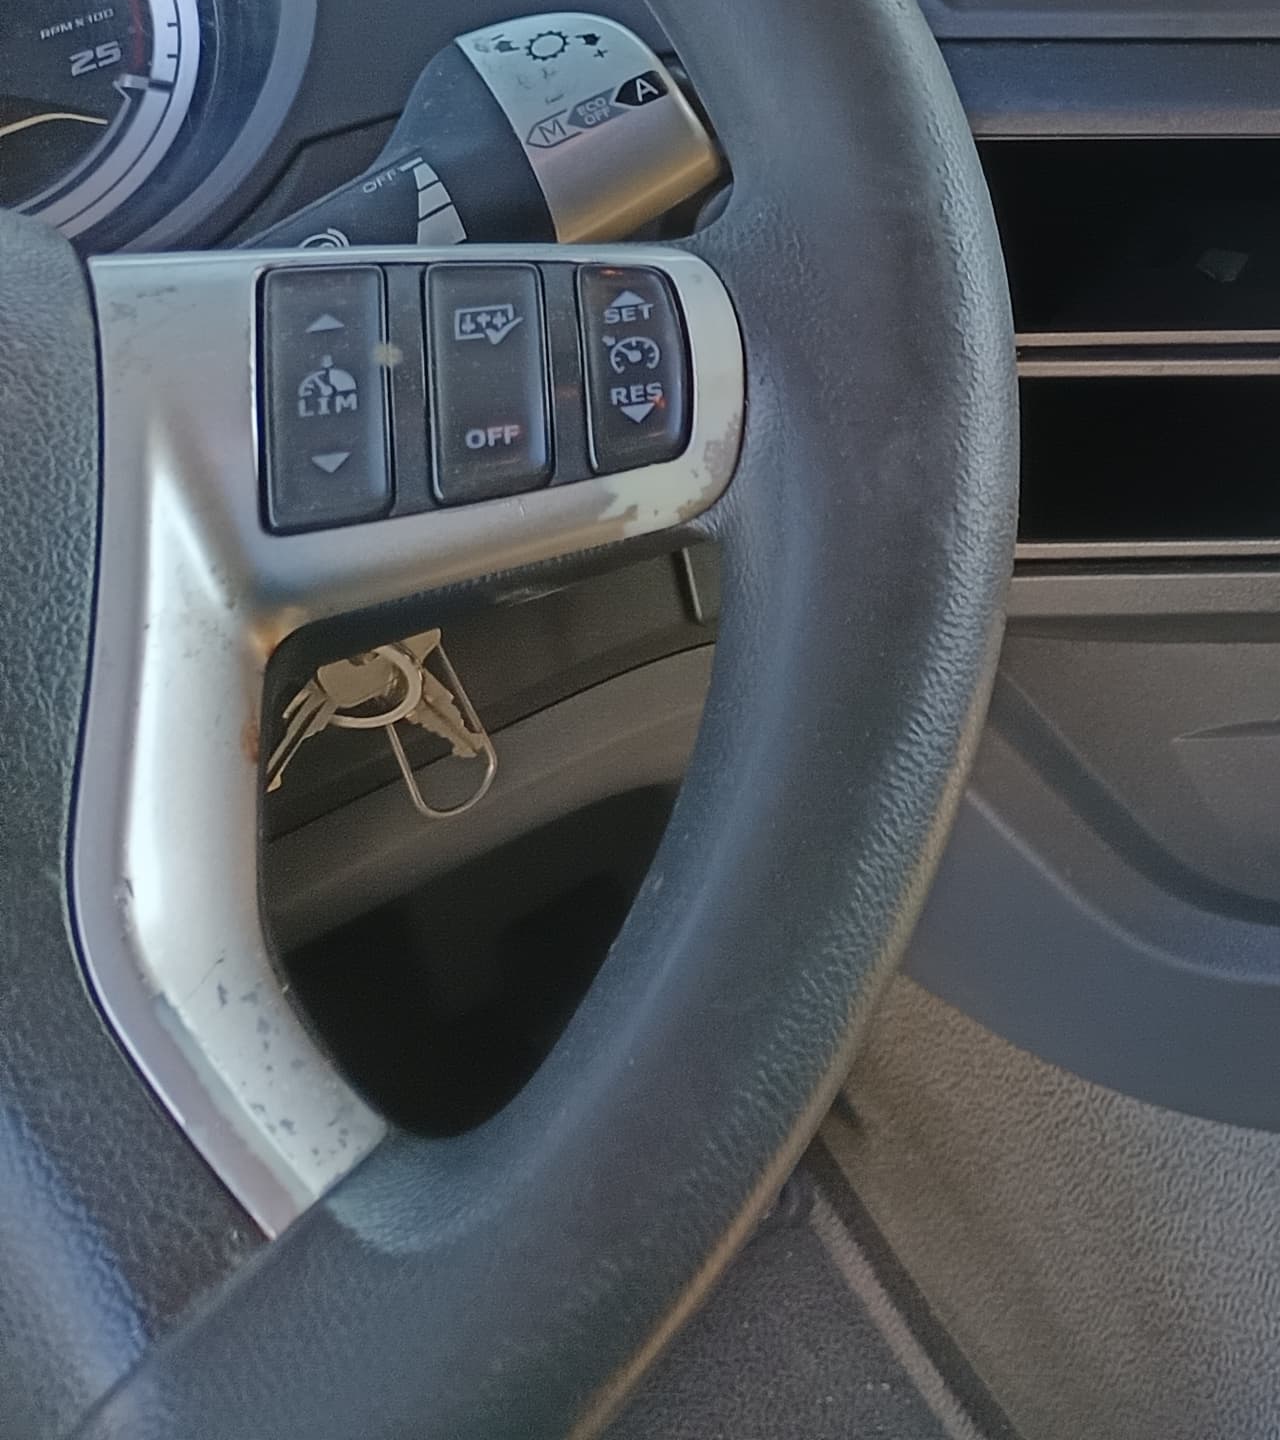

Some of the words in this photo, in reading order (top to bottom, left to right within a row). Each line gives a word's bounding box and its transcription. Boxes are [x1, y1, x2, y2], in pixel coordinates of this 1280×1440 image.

[40, 21, 73, 40] RPM
[88, 8, 114, 24] 100
[69, 40, 121, 76] 25
[635, 78, 659, 102] A
[576, 97, 606, 116] ECO
[584, 106, 610, 126] OFF
[538, 118, 567, 144] M
[362, 168, 396, 193] OFF
[603, 303, 654, 325] SET
[299, 393, 358, 417] LIM
[610, 382, 663, 405] RES
[465, 425, 520, 450] OFF
